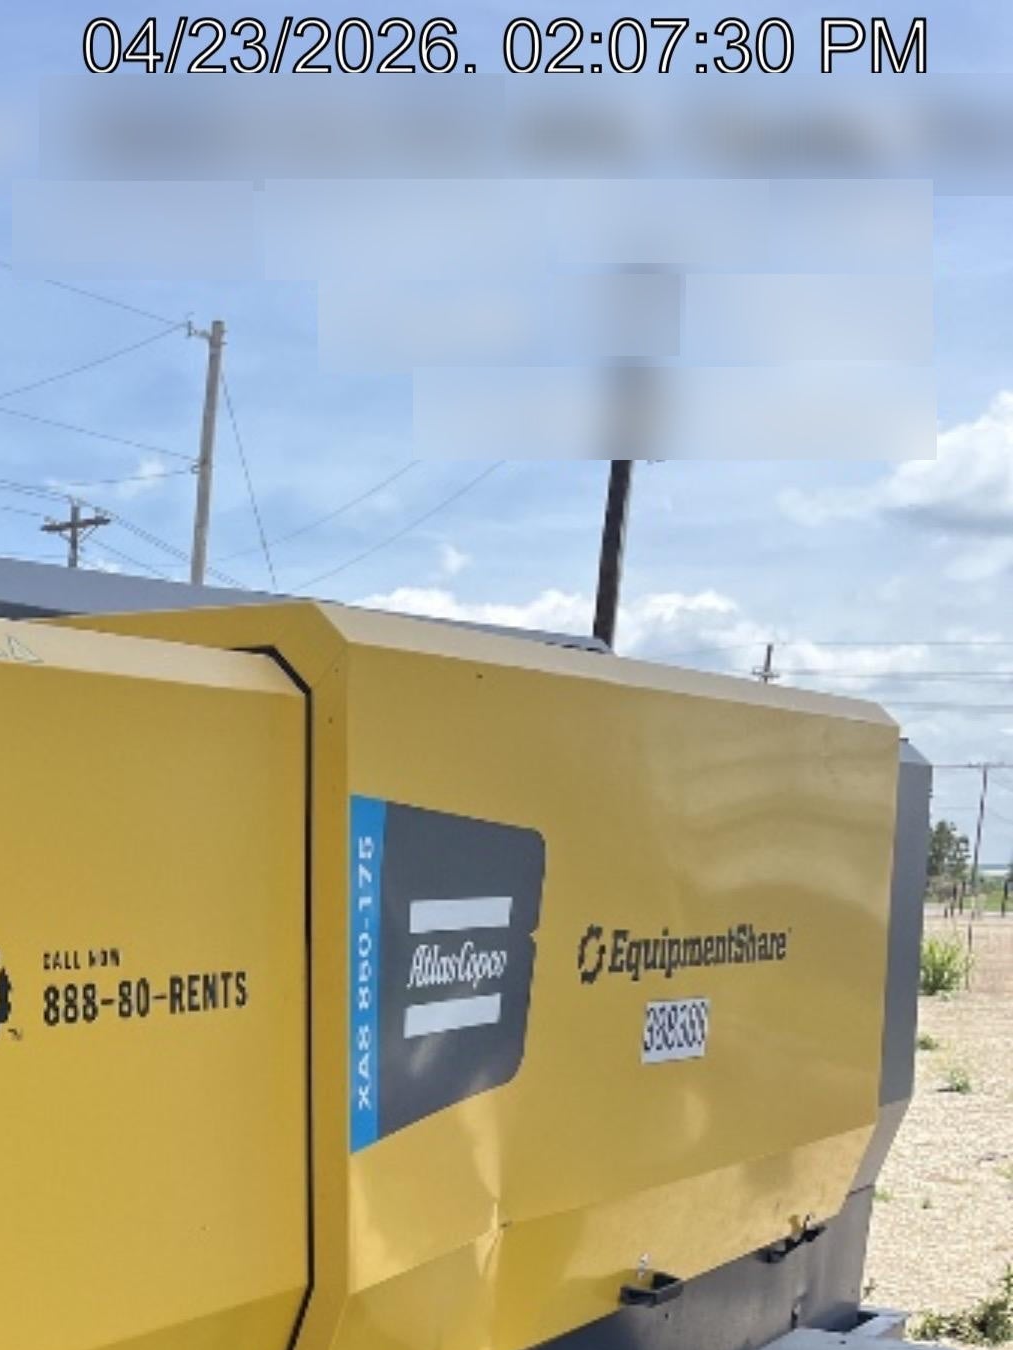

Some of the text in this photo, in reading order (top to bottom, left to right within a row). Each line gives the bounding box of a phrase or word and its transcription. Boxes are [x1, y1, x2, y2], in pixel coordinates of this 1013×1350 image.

[43, 950, 81, 970] CALL
[608, 923, 787, 982] EquipmentShare
[43, 970, 247, 1027] 888-80-RENTS
